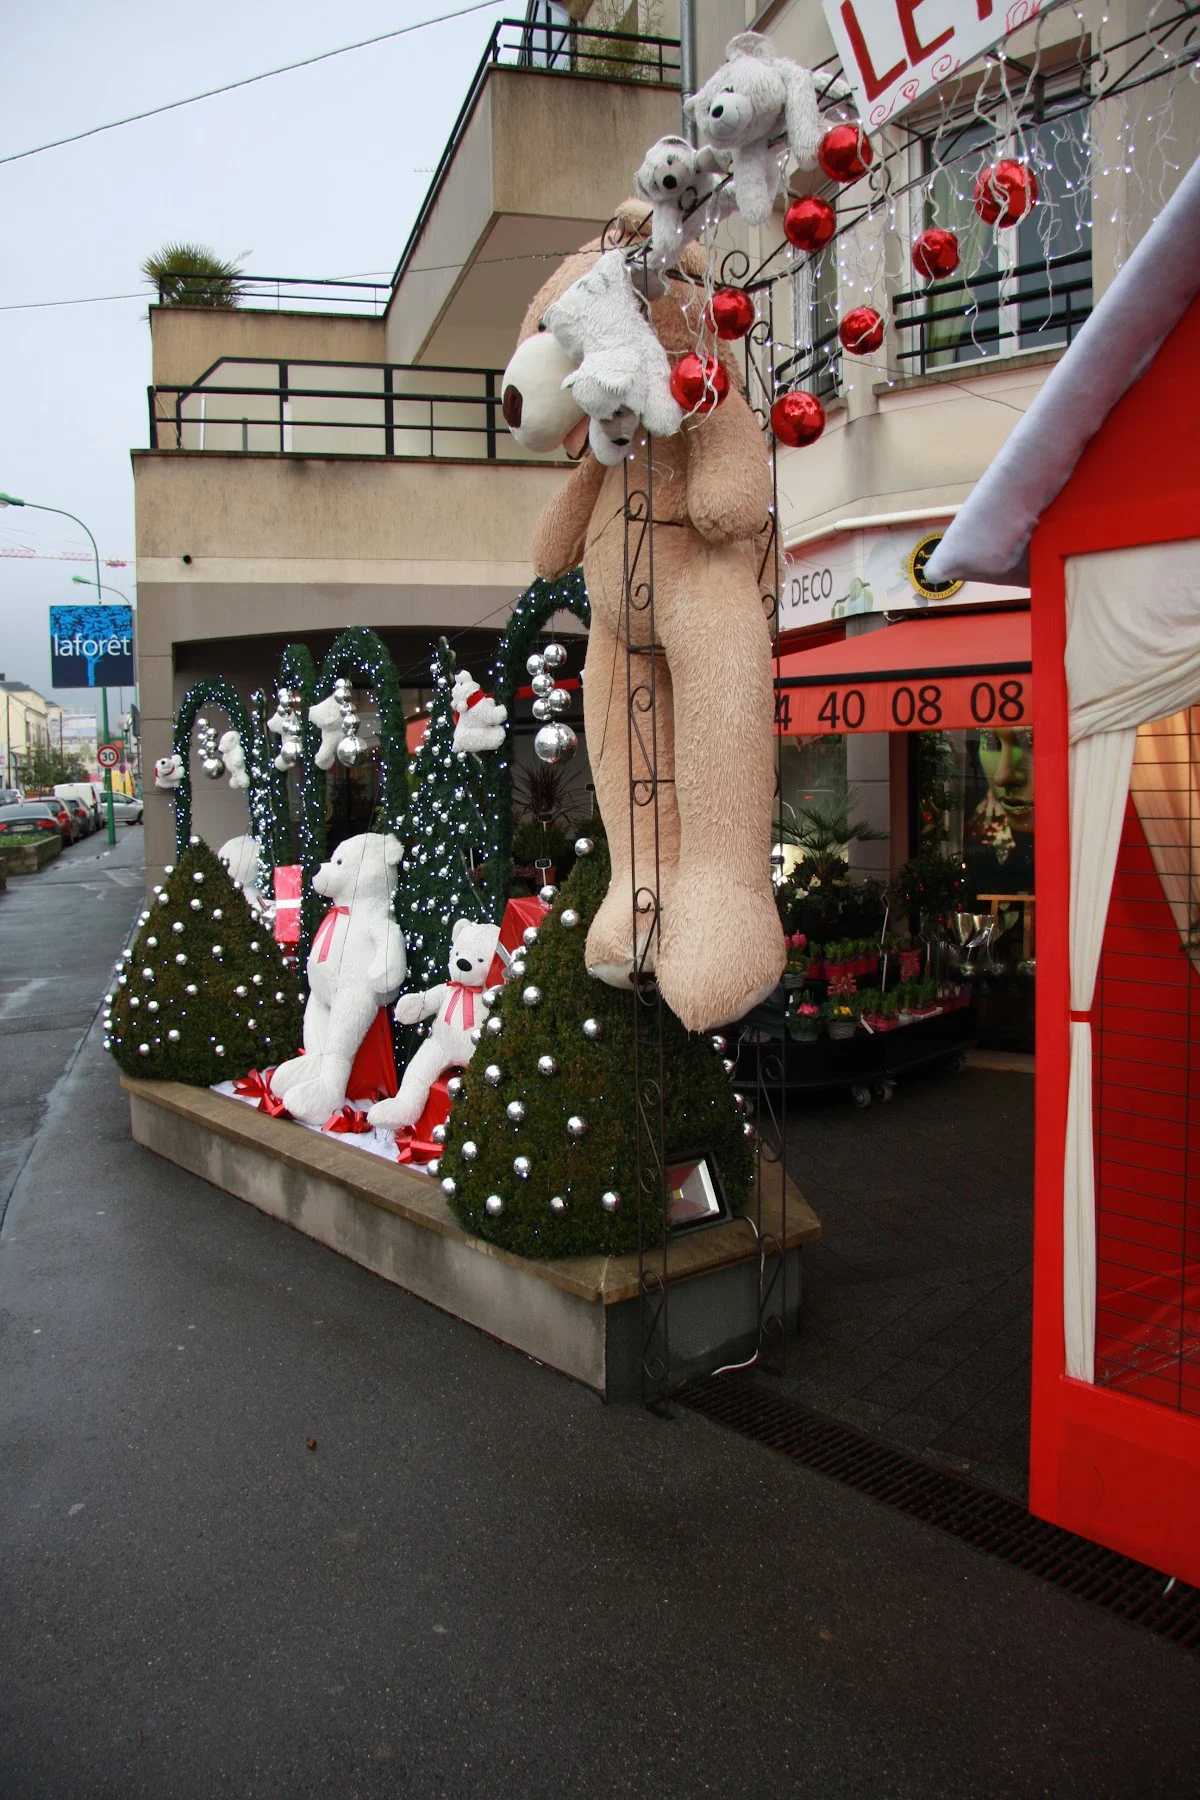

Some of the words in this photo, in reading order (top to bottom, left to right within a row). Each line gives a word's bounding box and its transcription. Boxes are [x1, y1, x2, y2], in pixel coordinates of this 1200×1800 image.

[840, 0, 993, 103] LE
[791, 568, 833, 608] DECO
[918, 586, 958, 598] INTERFLORA
[54, 633, 131, 656] laforêt
[817, 689, 865, 730] 40
[891, 685, 943, 727] 08
[970, 680, 1025, 723] 08
[101, 752, 115, 762] 30
